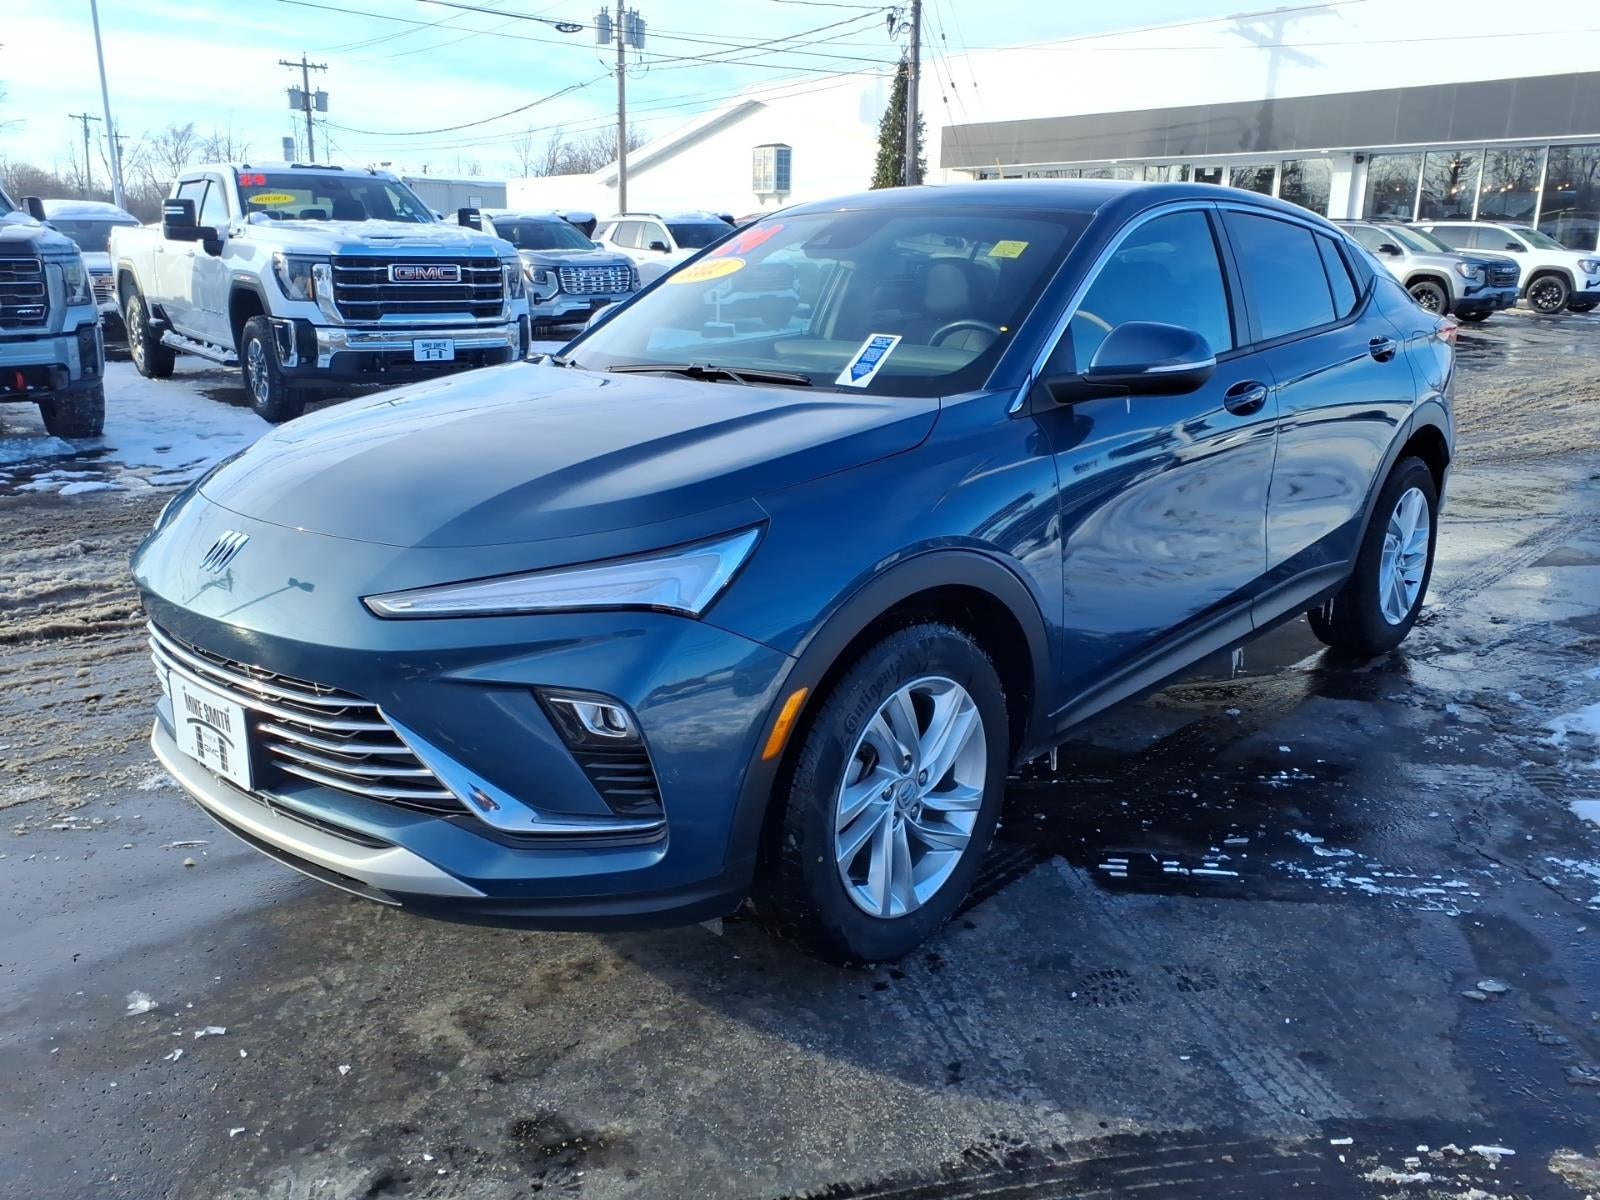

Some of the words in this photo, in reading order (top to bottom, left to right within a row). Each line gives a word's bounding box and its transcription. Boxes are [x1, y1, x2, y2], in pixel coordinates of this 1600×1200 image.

[394, 266, 457, 280] GMC
[184, 692, 203, 720] MIKE
[203, 703, 232, 733] SMITH
